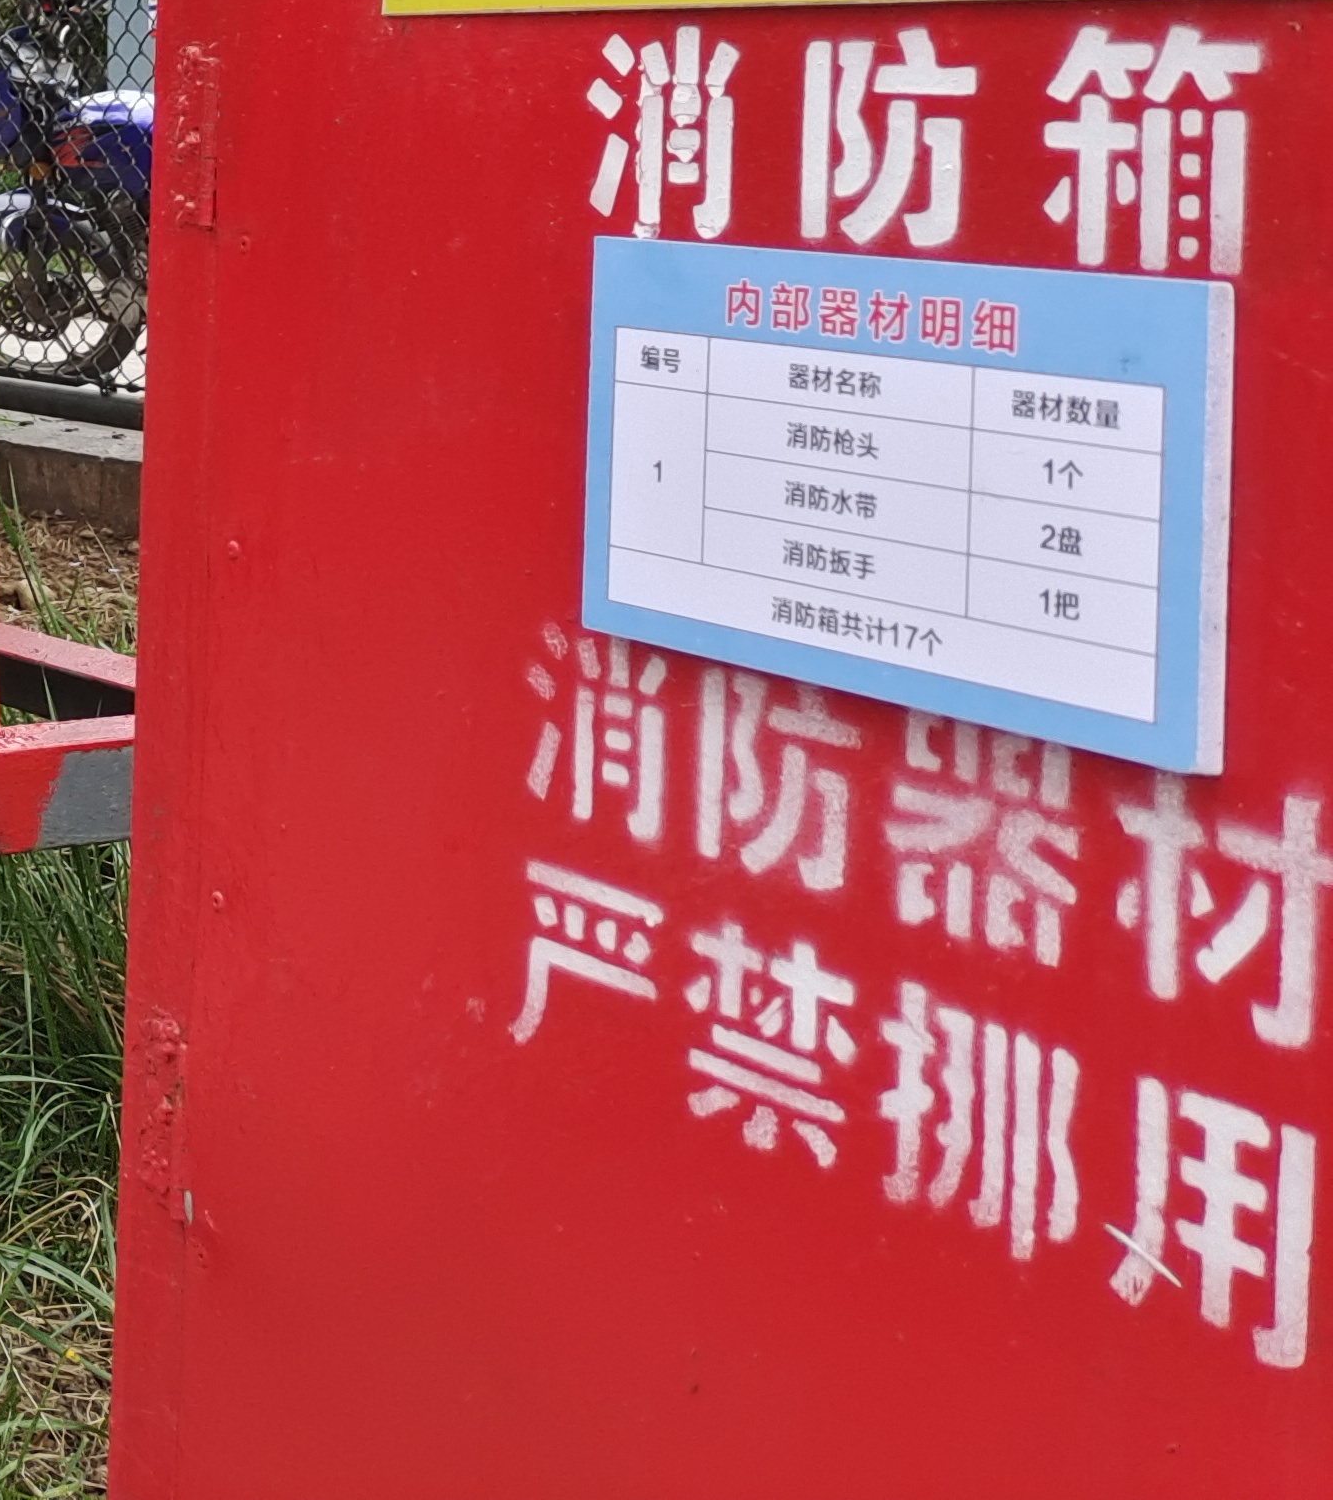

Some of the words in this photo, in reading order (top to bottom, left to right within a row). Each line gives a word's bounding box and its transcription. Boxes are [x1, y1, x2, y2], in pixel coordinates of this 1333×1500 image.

[586, 26, 1262, 275] 消防箱
[726, 278, 1021, 355] 内部器材明细
[640, 345, 681, 374] 编号
[788, 362, 882, 400] 器材名称
[1011, 389, 1121, 431] 器材数量
[651, 460, 663, 483] 1
[786, 421, 879, 461] 消防枪头
[1043, 459, 1084, 490] 1个
[784, 480, 878, 520] 消防水带
[1039, 523, 1083, 557] 2盘
[782, 538, 876, 580] 消防扳手
[1038, 589, 1080, 623] 1把
[770, 596, 944, 656] 消防箱共计17个
[526, 622, 1333, 1049] 消防器材
[507, 861, 1318, 1370] 严禁挪用
